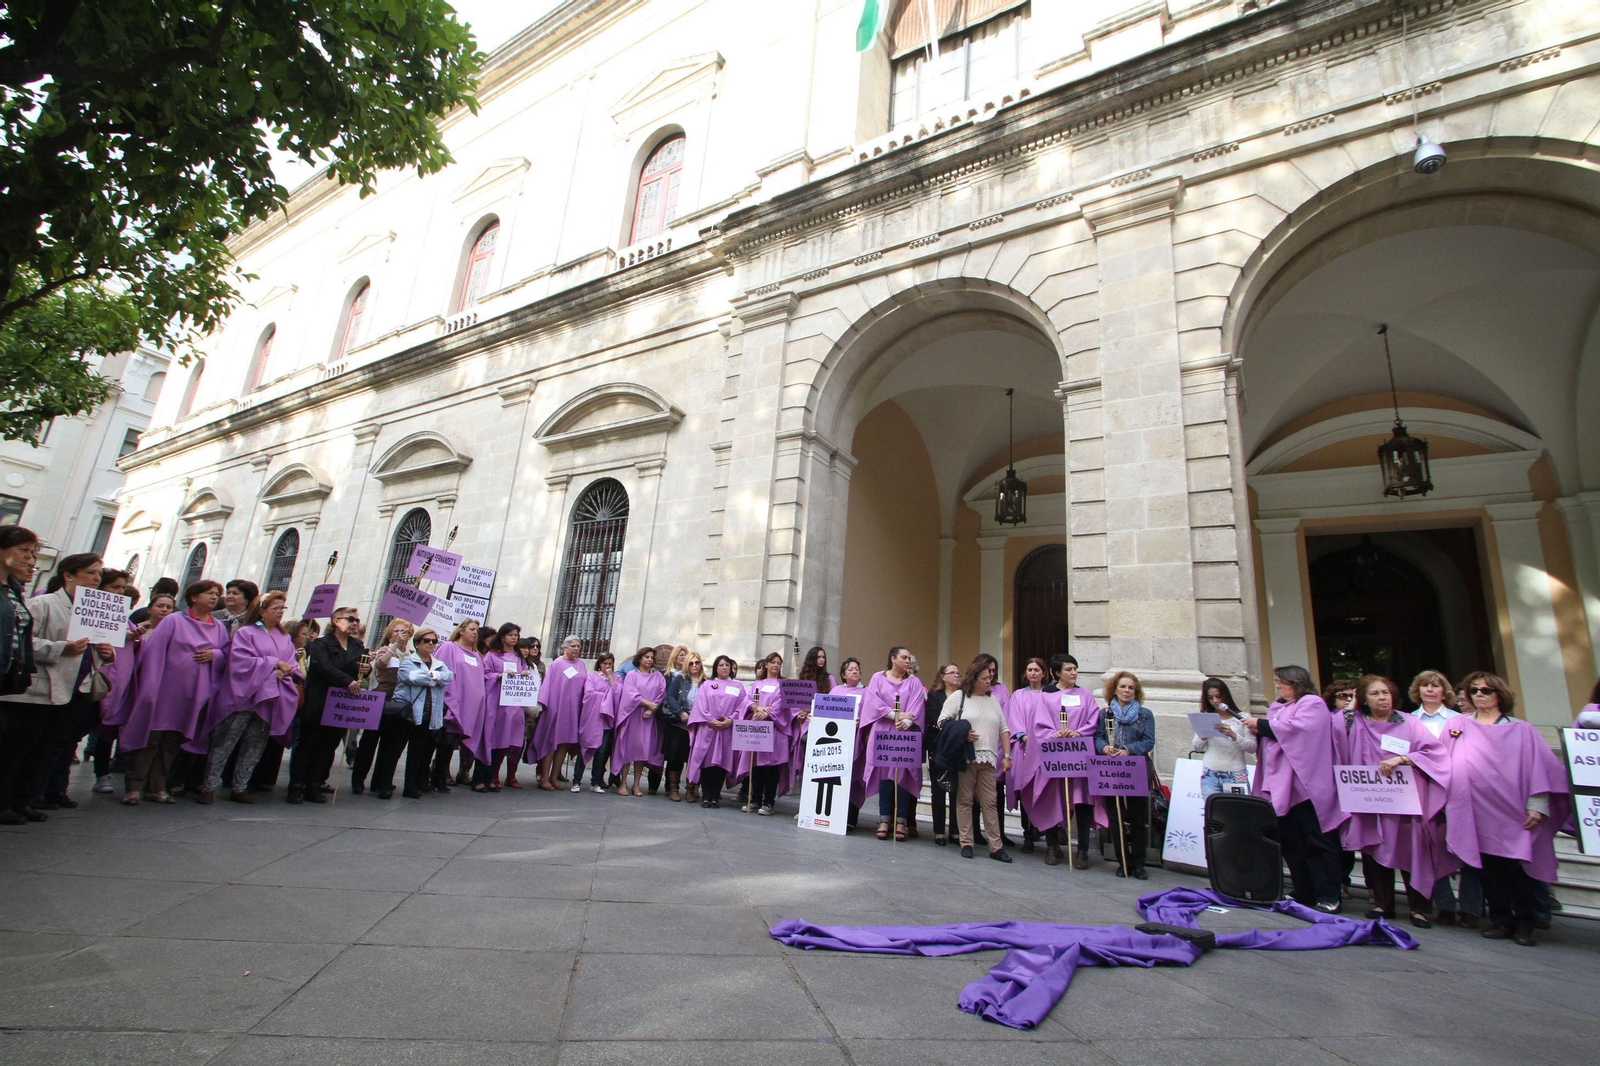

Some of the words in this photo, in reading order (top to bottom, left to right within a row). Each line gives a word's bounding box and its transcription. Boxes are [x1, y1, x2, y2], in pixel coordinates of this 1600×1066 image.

[471, 568, 492, 577] MURIÓ
[457, 577, 491, 589] ASESINADA
[85, 589, 111, 602] BASTA
[113, 595, 125, 605] DE
[391, 584, 417, 602] SANDRA
[415, 593, 429, 608] M.A.
[453, 594, 463, 602] NO
[81, 597, 125, 614] VIOLENCIA
[74, 606, 110, 620] CONTRA
[111, 614, 127, 624] LAS
[80, 617, 120, 631] MUJERES
[334, 702, 370, 713] Alicante
[825, 704, 854, 713] ASESINADA
[333, 713, 344, 721] 76
[345, 716, 366, 724] años
[735, 724, 748, 733] TERESA
[876, 734, 917, 742] HANANE
[1574, 731, 1600, 742] NO
[812, 747, 826, 757] Abril
[827, 745, 842, 755] 2015
[876, 744, 916, 753] Alicante
[1041, 741, 1088, 753] SUSANA
[876, 754, 889, 762] 43
[891, 755, 915, 763] años
[1089, 758, 1122, 767] Vecina
[1124, 759, 1137, 767] de
[811, 763, 819, 774] 13
[1099, 770, 1132, 779] LLeida
[1340, 770, 1383, 785] GISELA
[1098, 781, 1110, 790] 24
[1112, 781, 1136, 791] años
[1350, 786, 1405, 794] ORBA-ALICANTE
